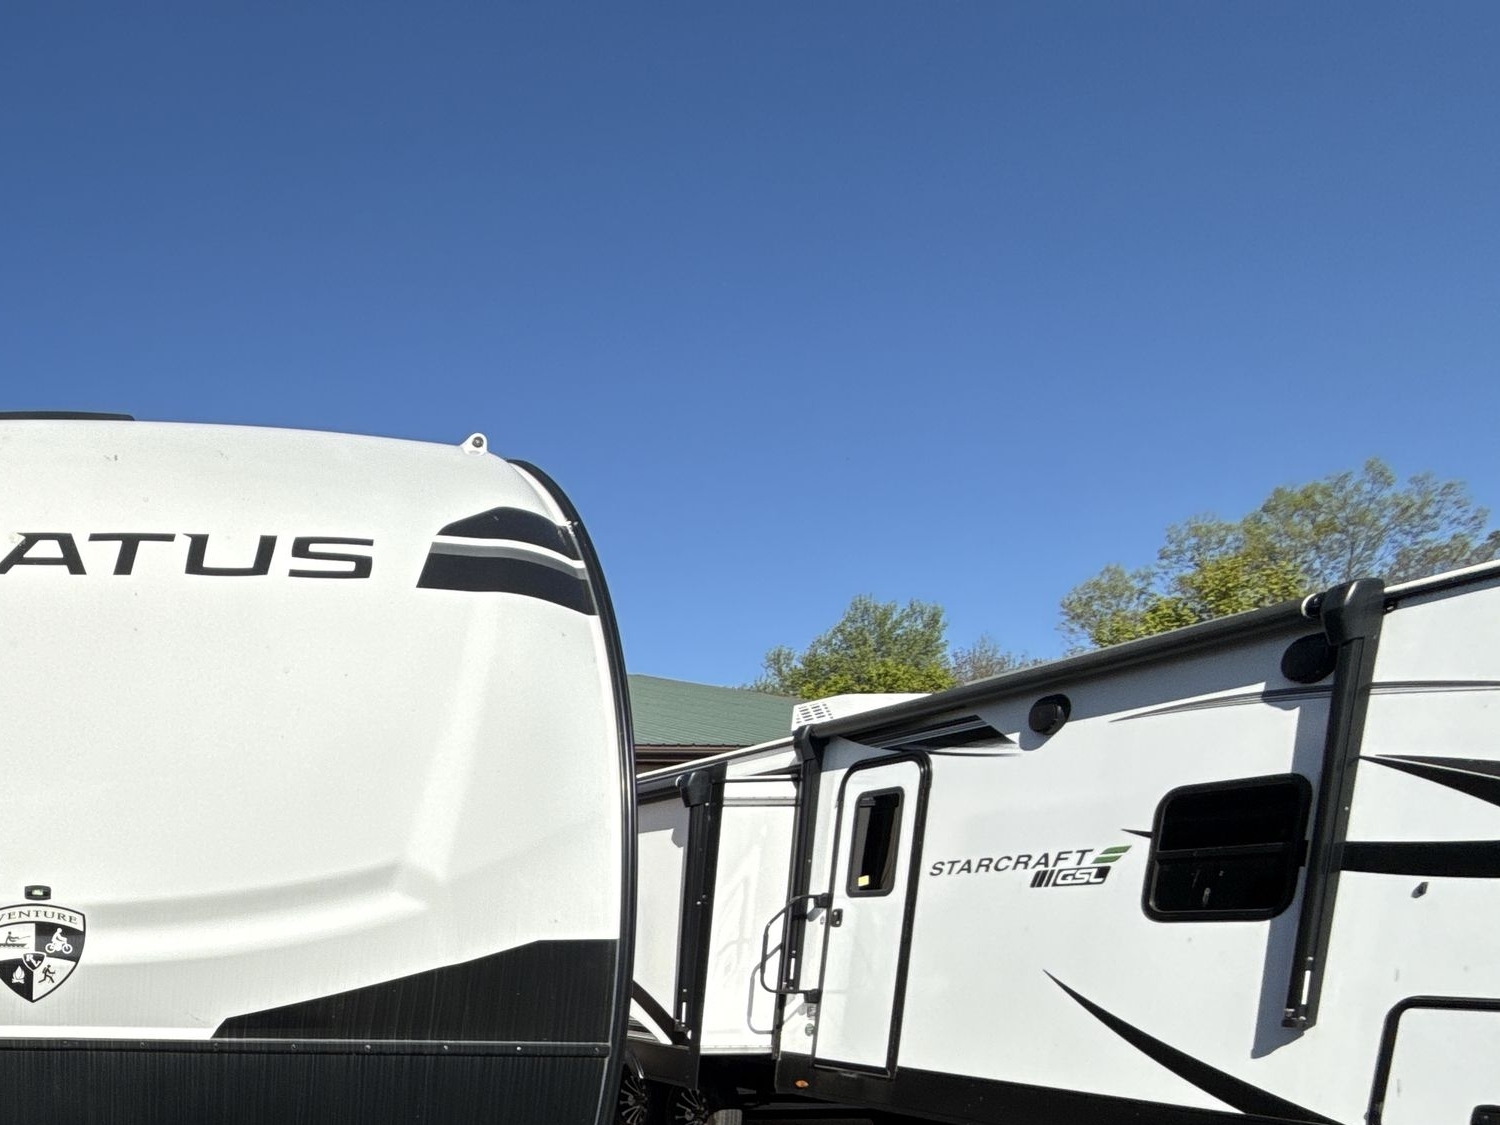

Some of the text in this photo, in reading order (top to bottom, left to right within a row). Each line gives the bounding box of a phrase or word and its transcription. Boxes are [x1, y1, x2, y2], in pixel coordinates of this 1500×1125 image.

[929, 849, 1094, 877] STARCRAFT
[1054, 867, 1107, 886] GSL
[25, 954, 42, 968] RV
